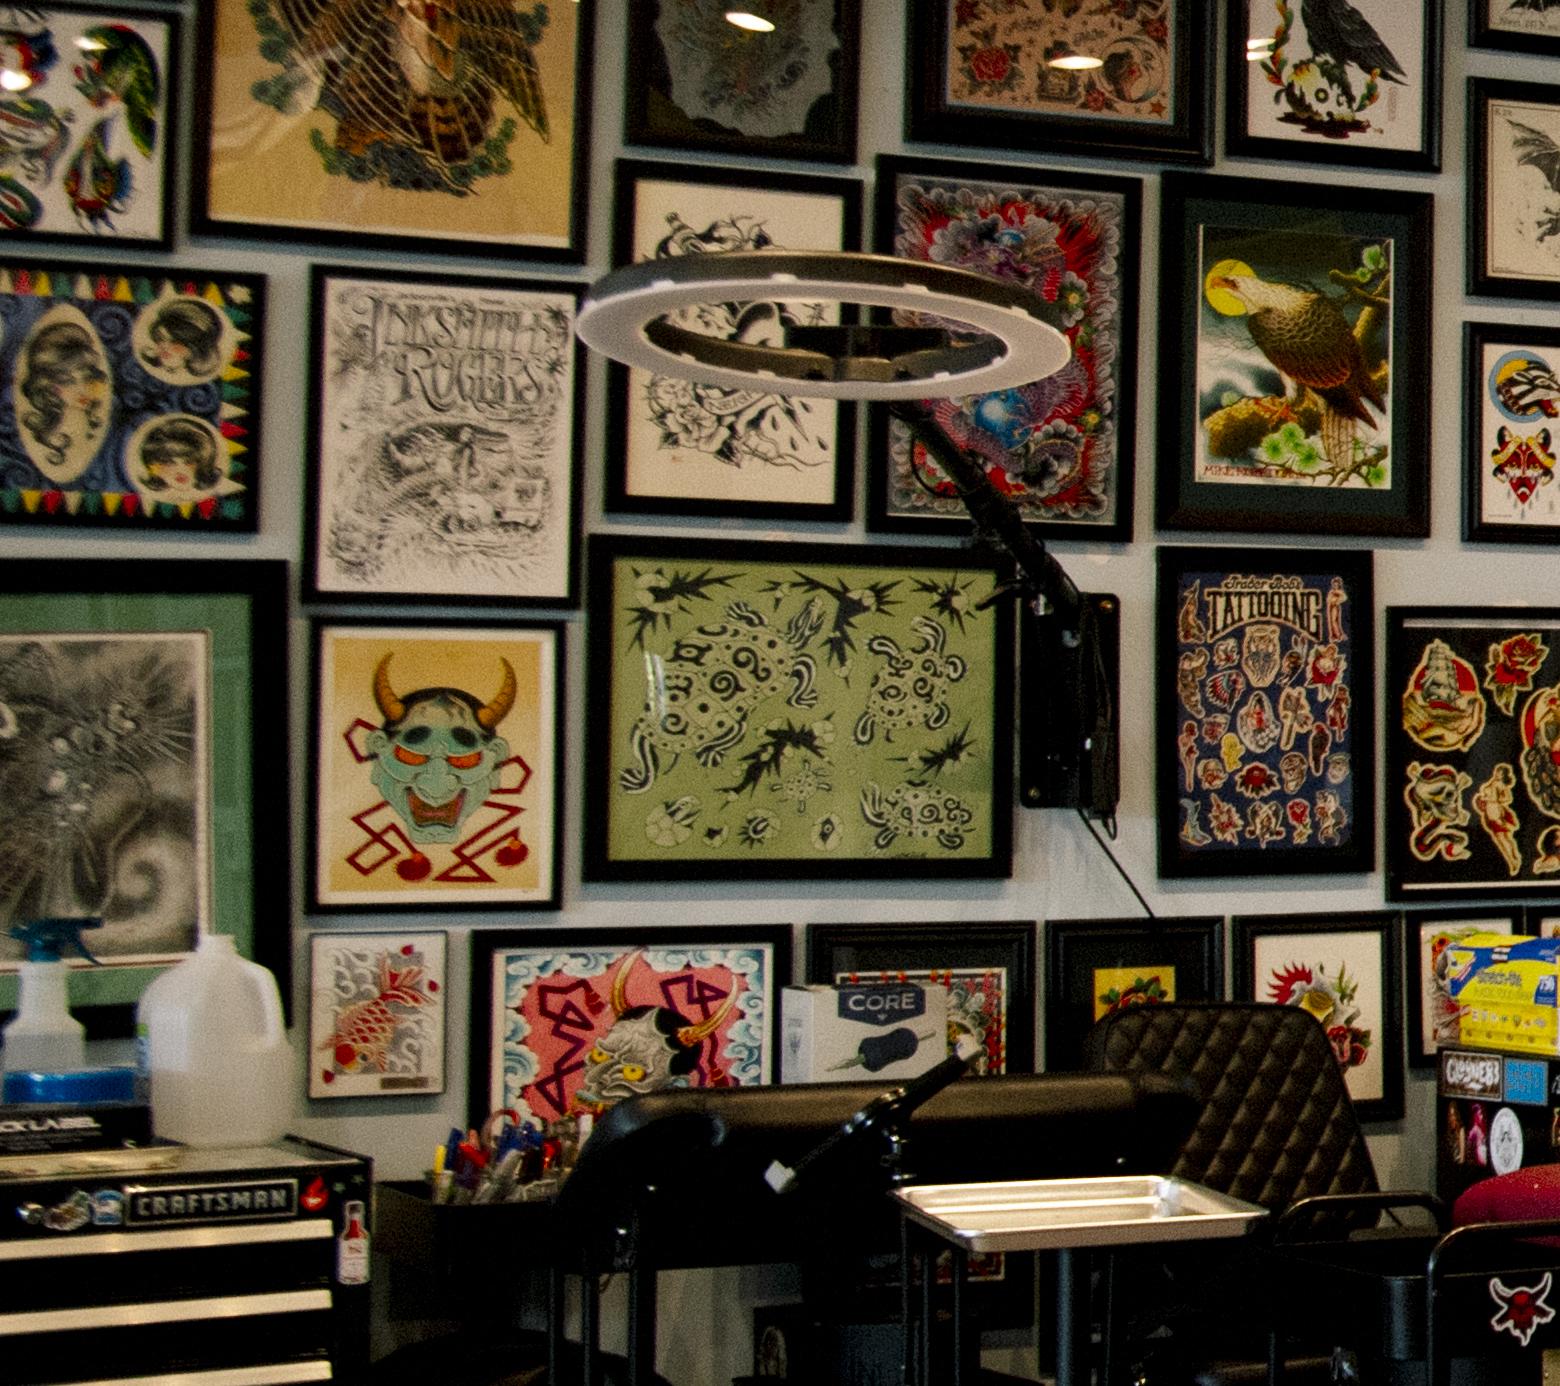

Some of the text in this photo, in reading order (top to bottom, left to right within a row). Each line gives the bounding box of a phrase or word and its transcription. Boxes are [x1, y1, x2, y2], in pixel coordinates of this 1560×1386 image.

[1206, 590, 1322, 640] TATTOOING
[849, 992, 916, 1012] CORE
[136, 1187, 287, 1216] CRAFTSMAN
